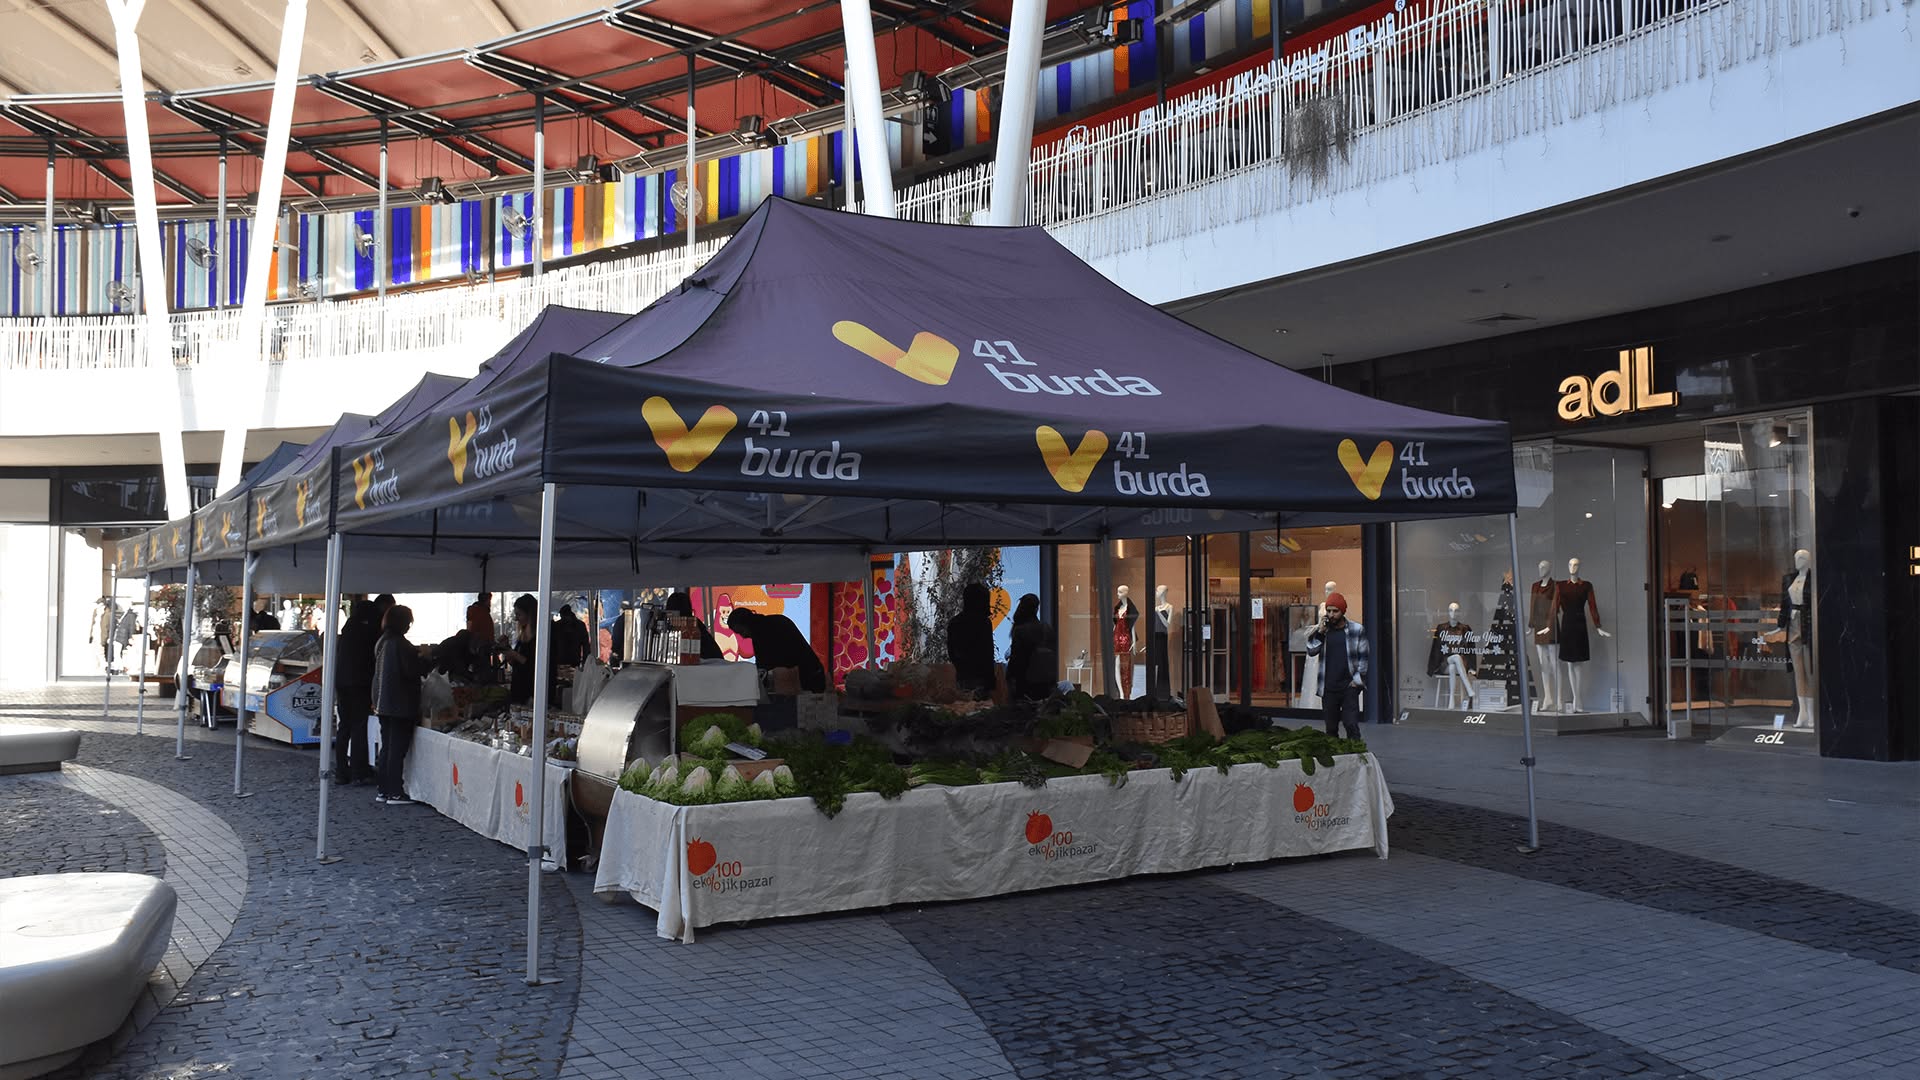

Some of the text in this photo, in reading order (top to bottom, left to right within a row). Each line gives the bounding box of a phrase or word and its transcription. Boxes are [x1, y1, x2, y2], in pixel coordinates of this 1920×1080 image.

[972, 339, 1038, 366] 41
[984, 363, 1162, 396] burda
[1557, 346, 1679, 421] adL
[748, 410, 791, 437] 41
[473, 428, 517, 479] burda
[1115, 431, 1150, 459] 41
[1399, 441, 1429, 467] 41
[740, 437, 862, 482] burda
[1114, 460, 1211, 498] burda
[1402, 467, 1475, 500] burda
[1439, 631, 1504, 646] Happy New Year
[293, 697, 323, 707] AKMES
[1463, 713, 1487, 725] adL
[1754, 731, 1785, 745] adL
[1313, 803, 1330, 818] 100
[1051, 831, 1073, 847] 100
[715, 861, 743, 878] 100
